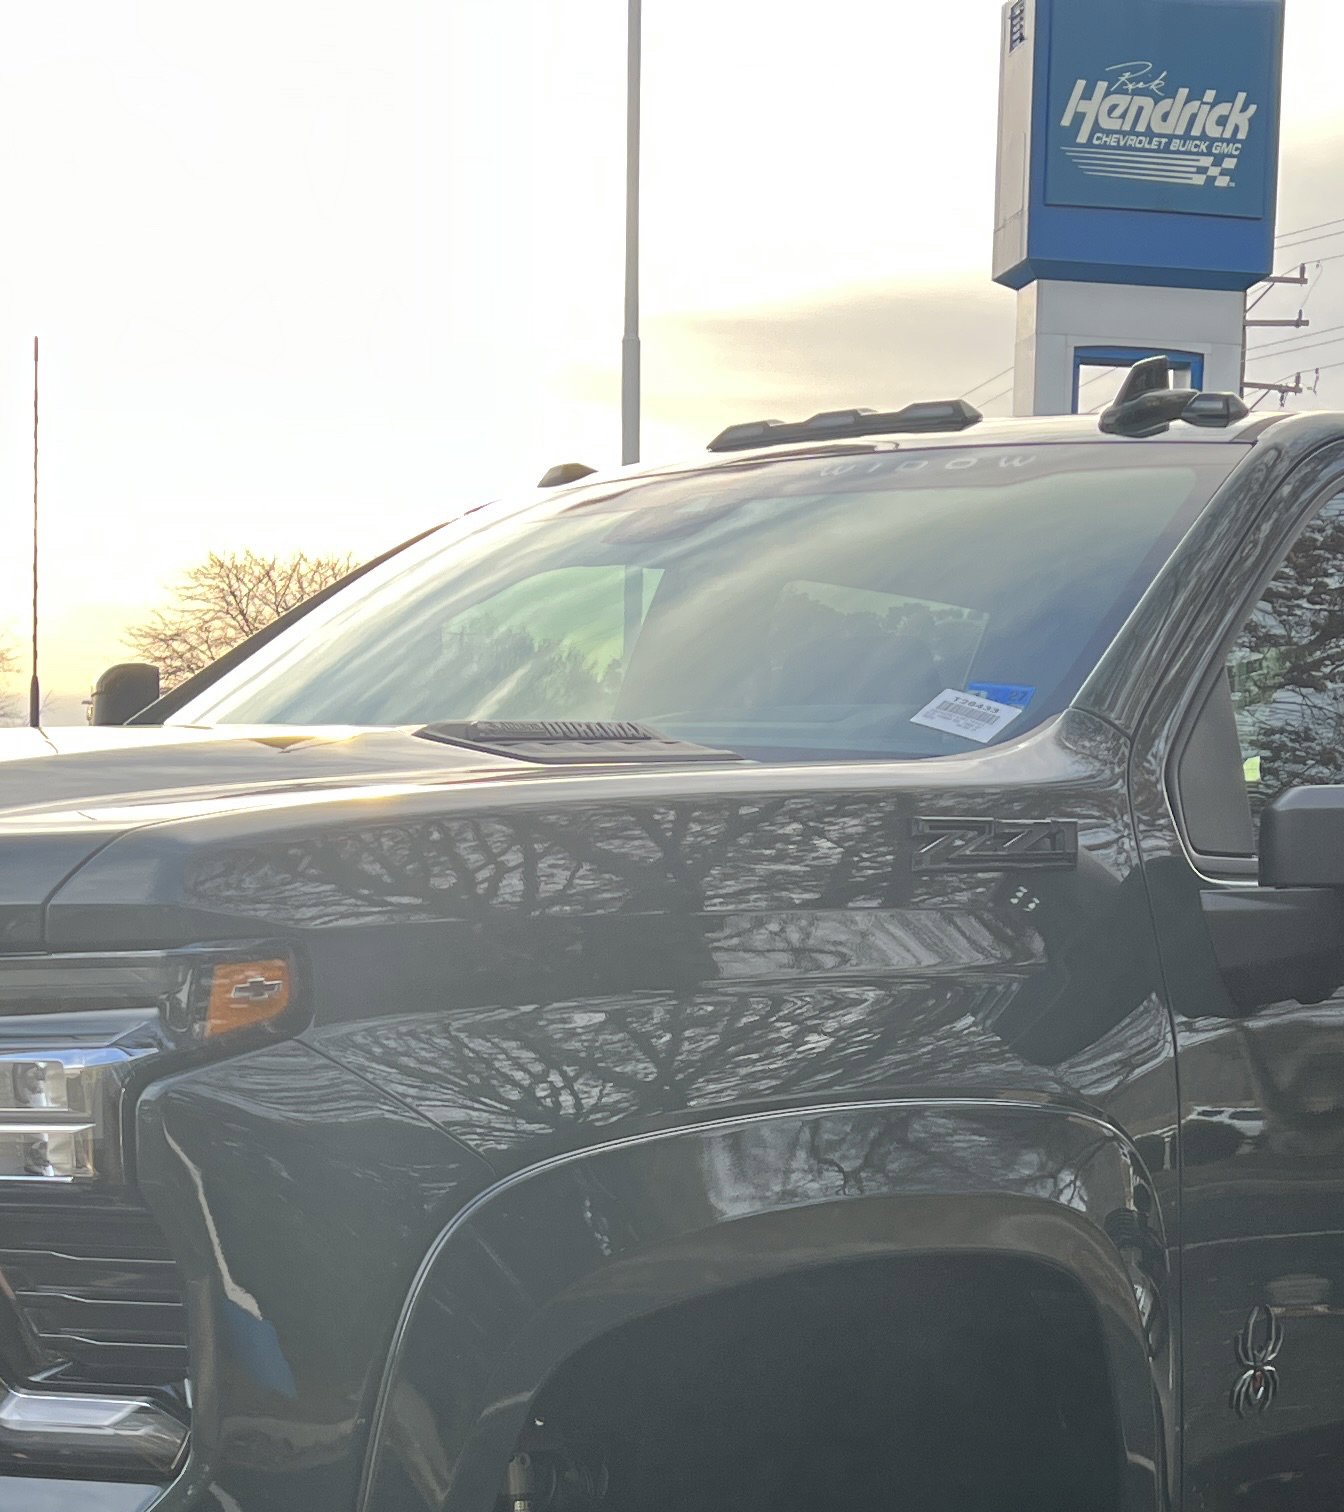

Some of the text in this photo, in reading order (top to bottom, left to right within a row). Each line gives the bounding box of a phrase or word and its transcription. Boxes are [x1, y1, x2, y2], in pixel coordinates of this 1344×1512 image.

[1060, 79, 1257, 144] Hendrick
[1092, 132, 1242, 155] CHEVROLET BUICK GMC
